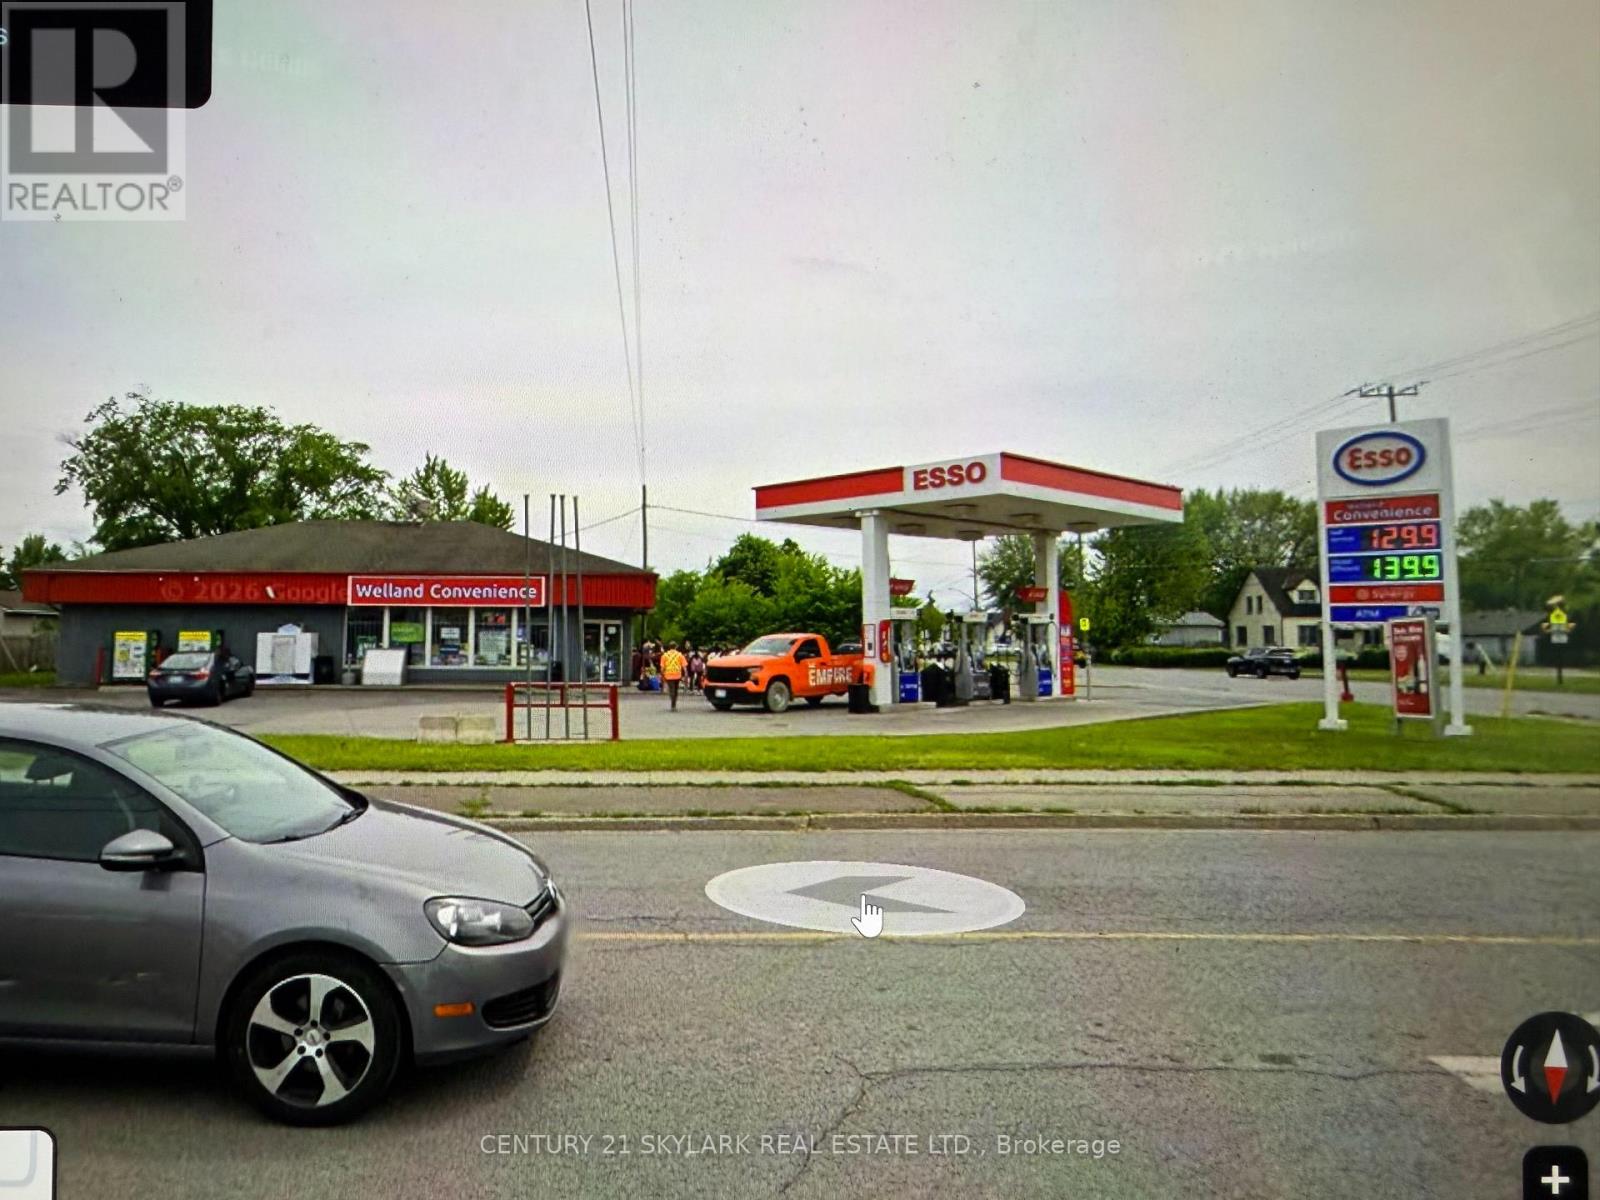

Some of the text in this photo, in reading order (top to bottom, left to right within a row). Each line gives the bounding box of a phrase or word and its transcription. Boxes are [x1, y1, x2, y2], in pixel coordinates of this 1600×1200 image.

[913, 461, 987, 490] ESSO
[1333, 506, 1433, 521] Convenience
[355, 583, 537, 599] Welland Convenience
